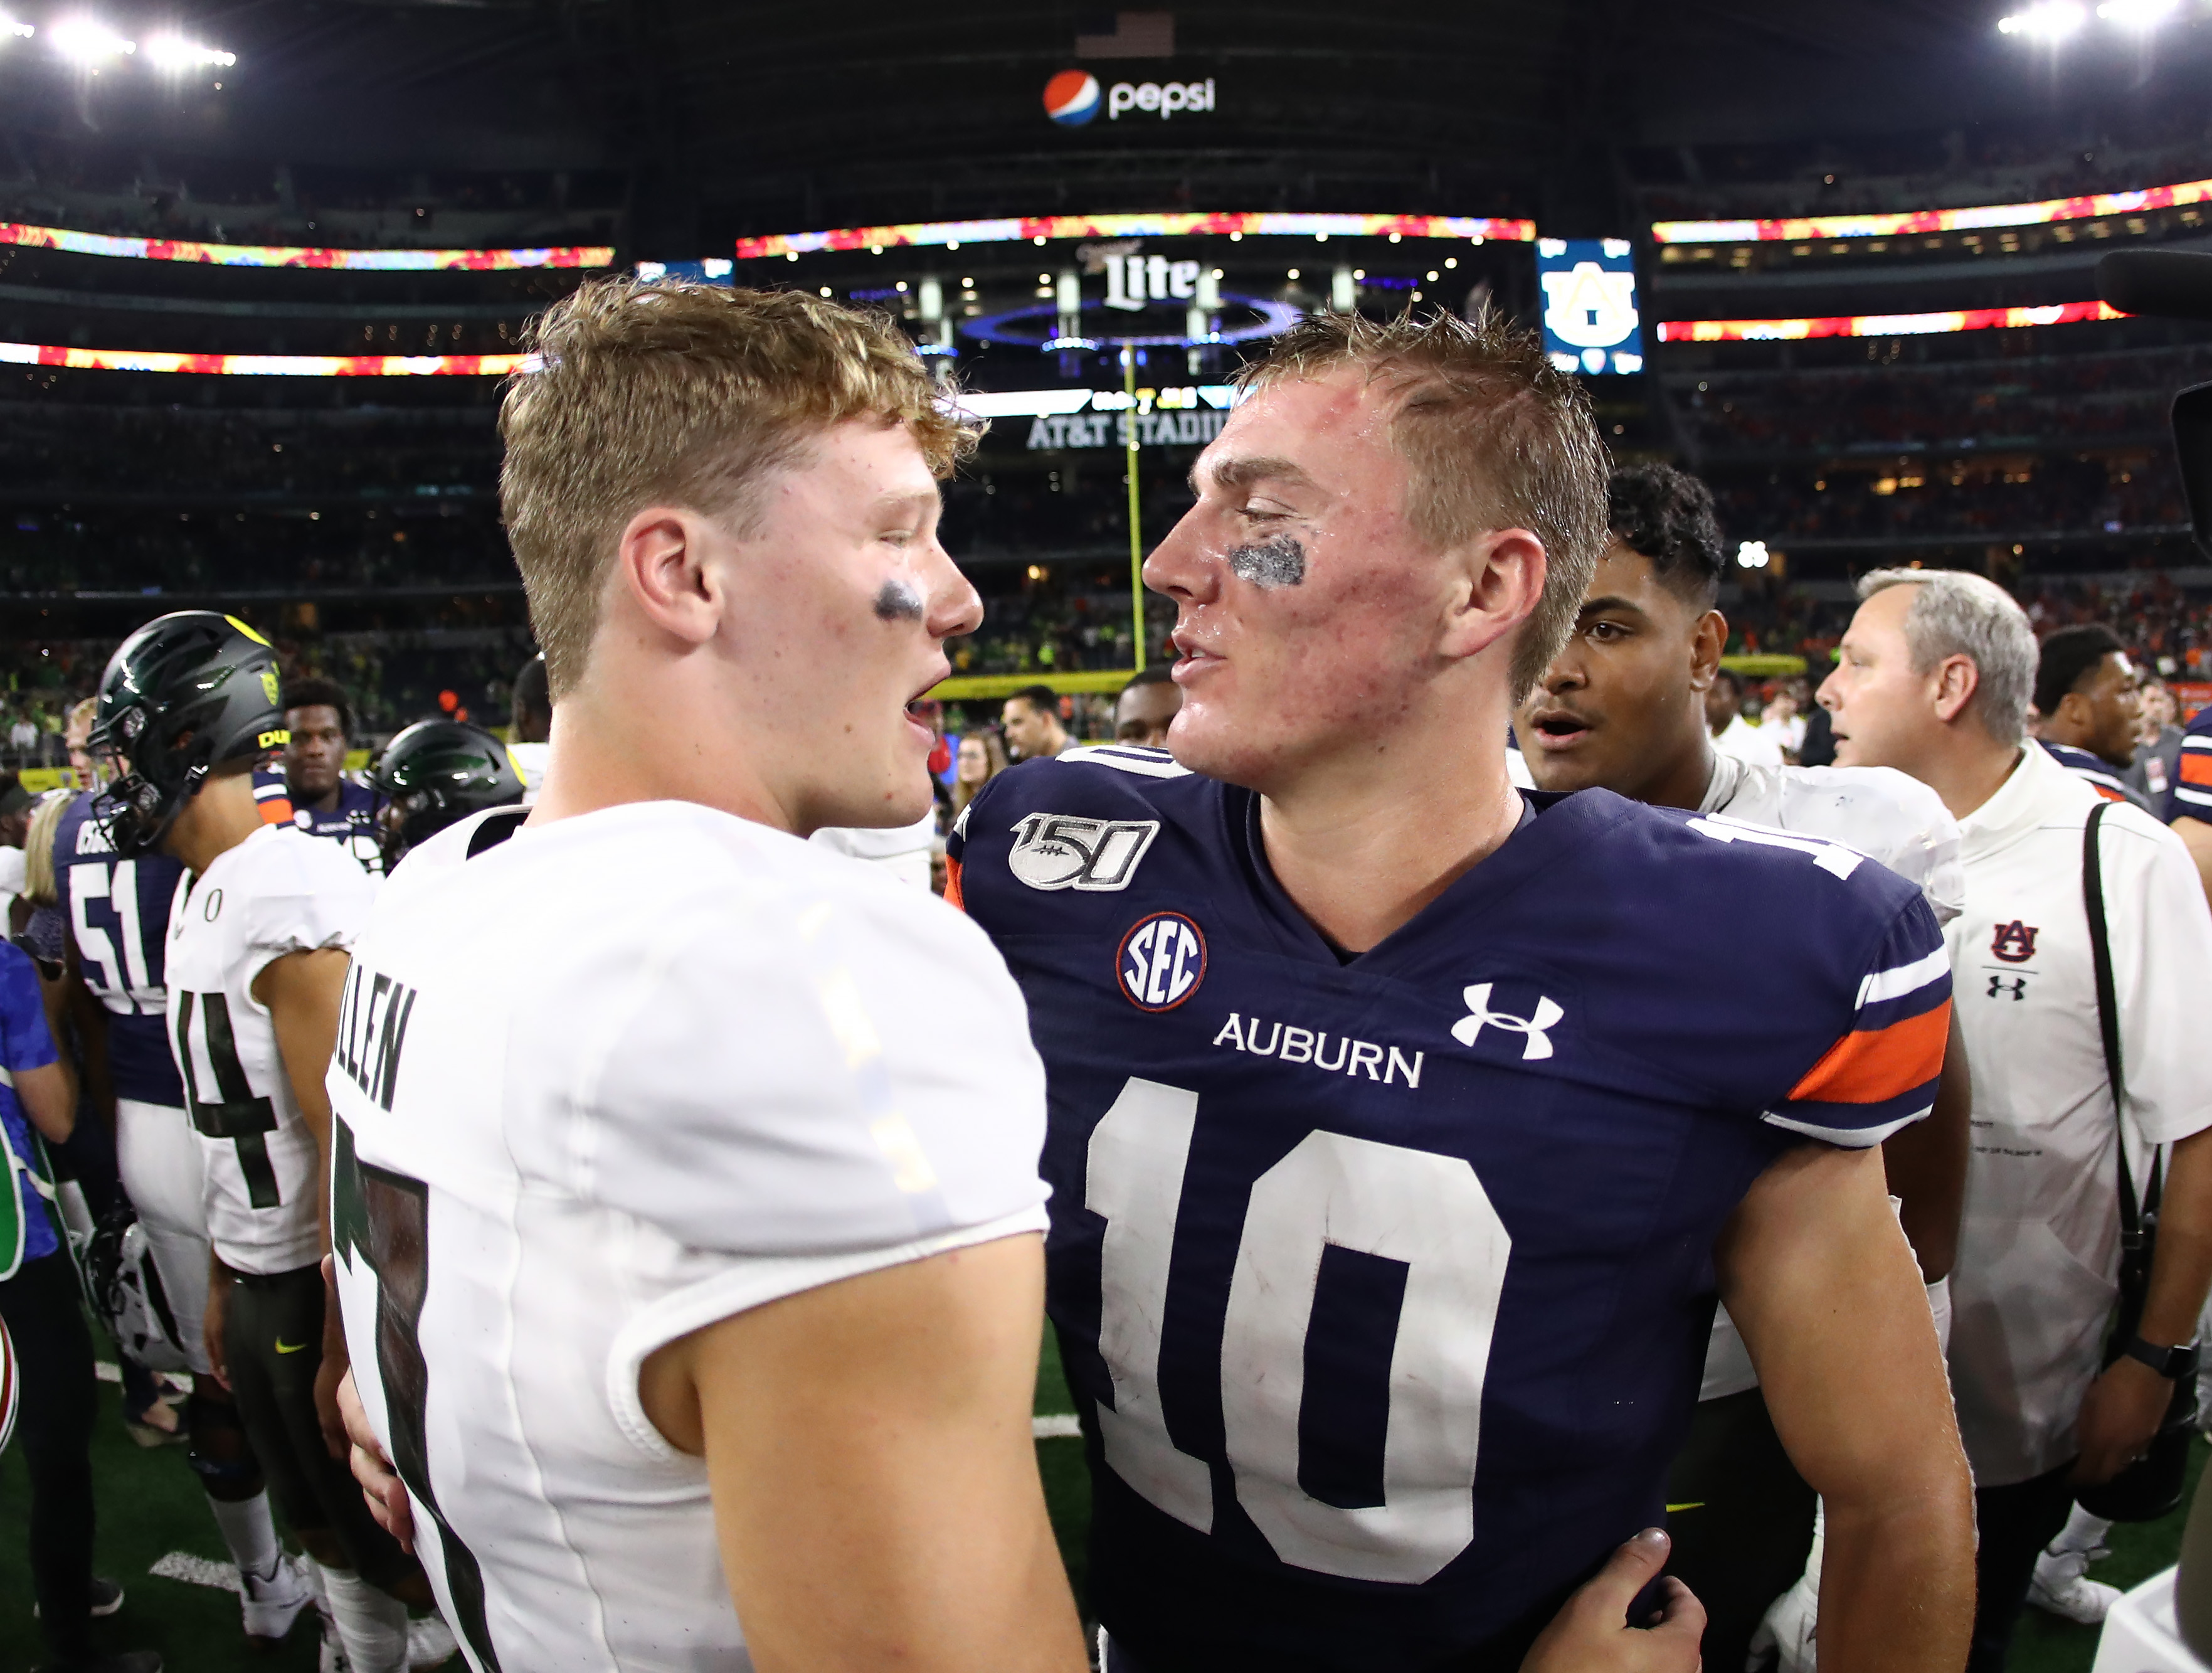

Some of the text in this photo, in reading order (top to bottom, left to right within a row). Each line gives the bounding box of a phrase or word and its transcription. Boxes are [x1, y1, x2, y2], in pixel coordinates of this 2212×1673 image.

[1109, 77, 1215, 120] pepsi
[1103, 253, 1200, 312] Lite
[1026, 412, 1112, 450] AT&T
[1010, 813, 1160, 891] 150
[69, 859, 167, 1015] 51
[1125, 920, 1199, 1004] SEC
[335, 957, 418, 1113] LLEN
[1213, 1012, 1424, 1089] AUBURN
[1085, 1076, 1512, 1585] 10
